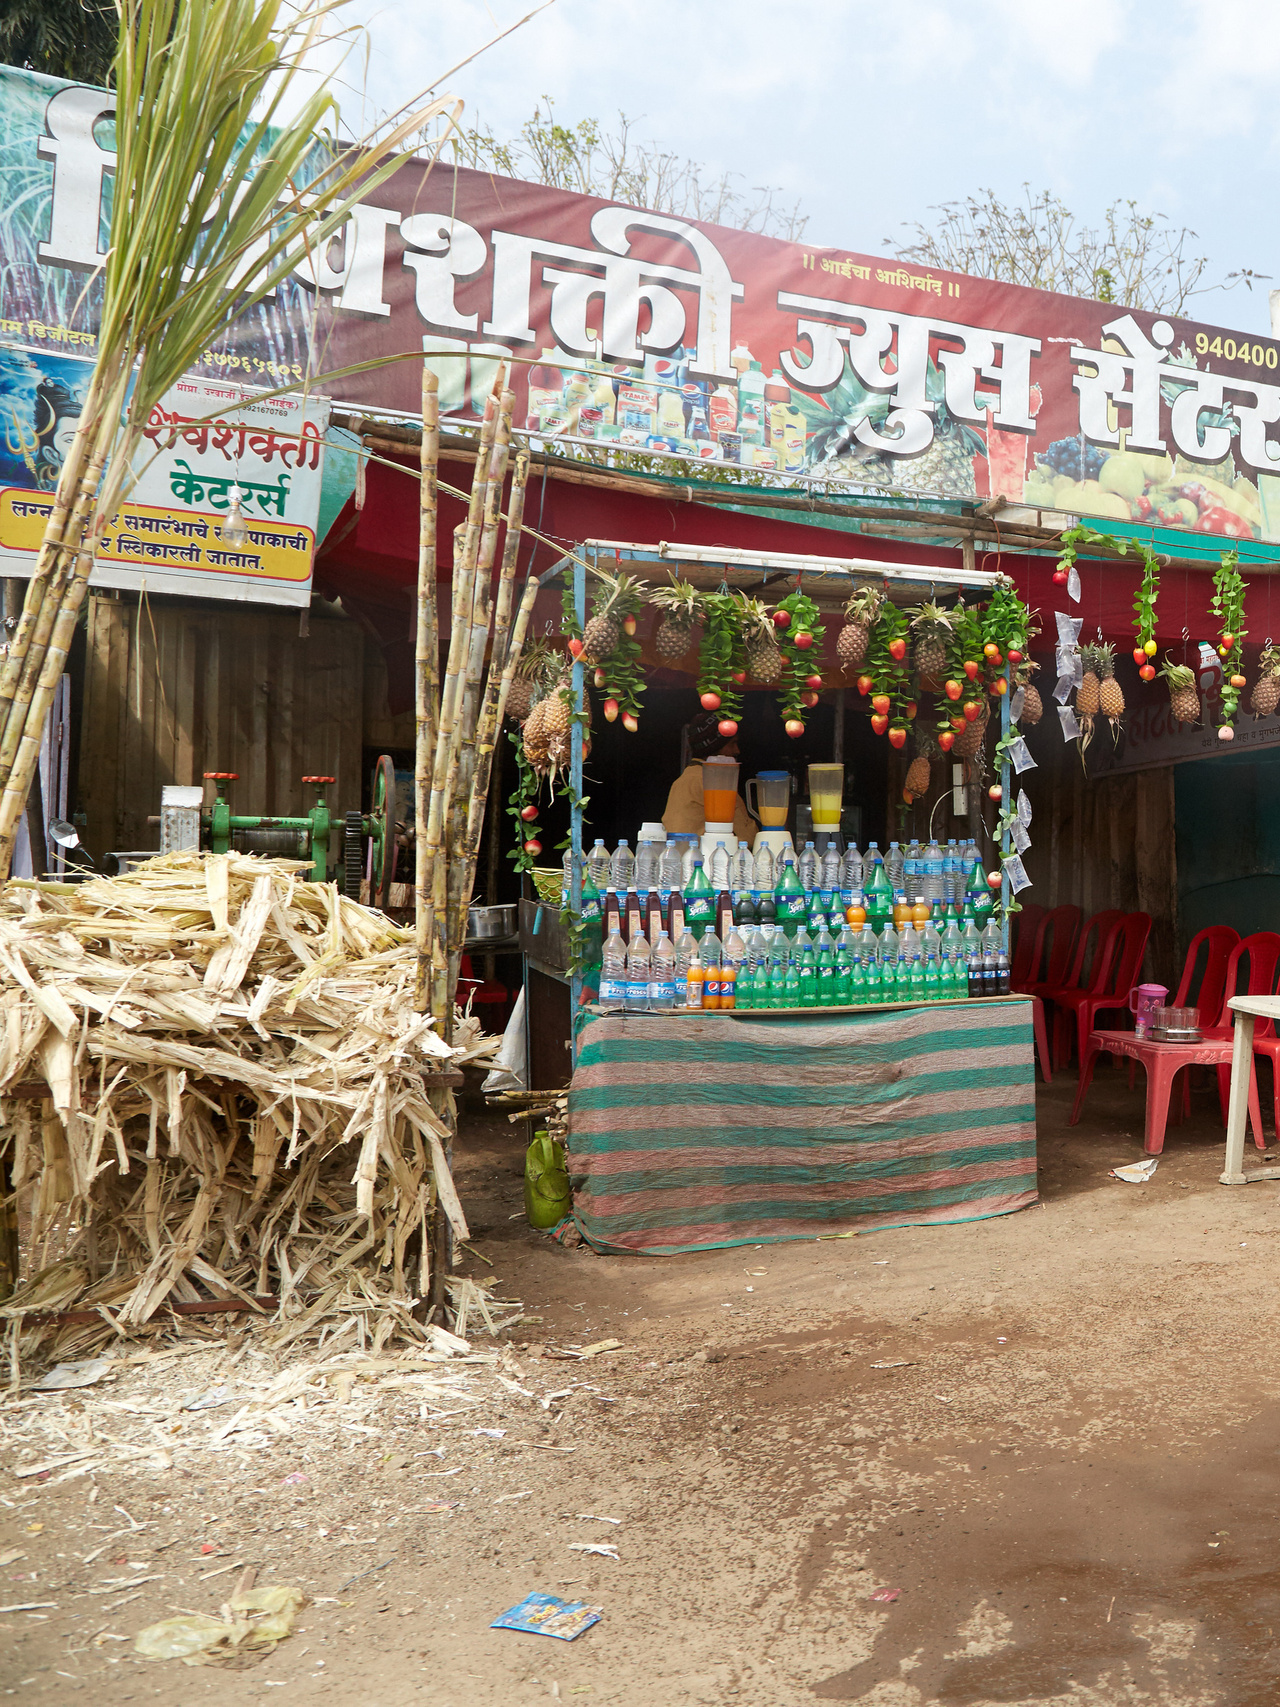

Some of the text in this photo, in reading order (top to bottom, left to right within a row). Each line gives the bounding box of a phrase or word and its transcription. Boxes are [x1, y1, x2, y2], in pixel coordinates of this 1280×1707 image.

[820, 259, 872, 281] आईचा
[875, 269, 944, 297] आशिर्वाद
[28, 319, 97, 347] डिजीटल
[778, 290, 1042, 456] ज्युस
[124, 514, 208, 539] समारंभाचे
